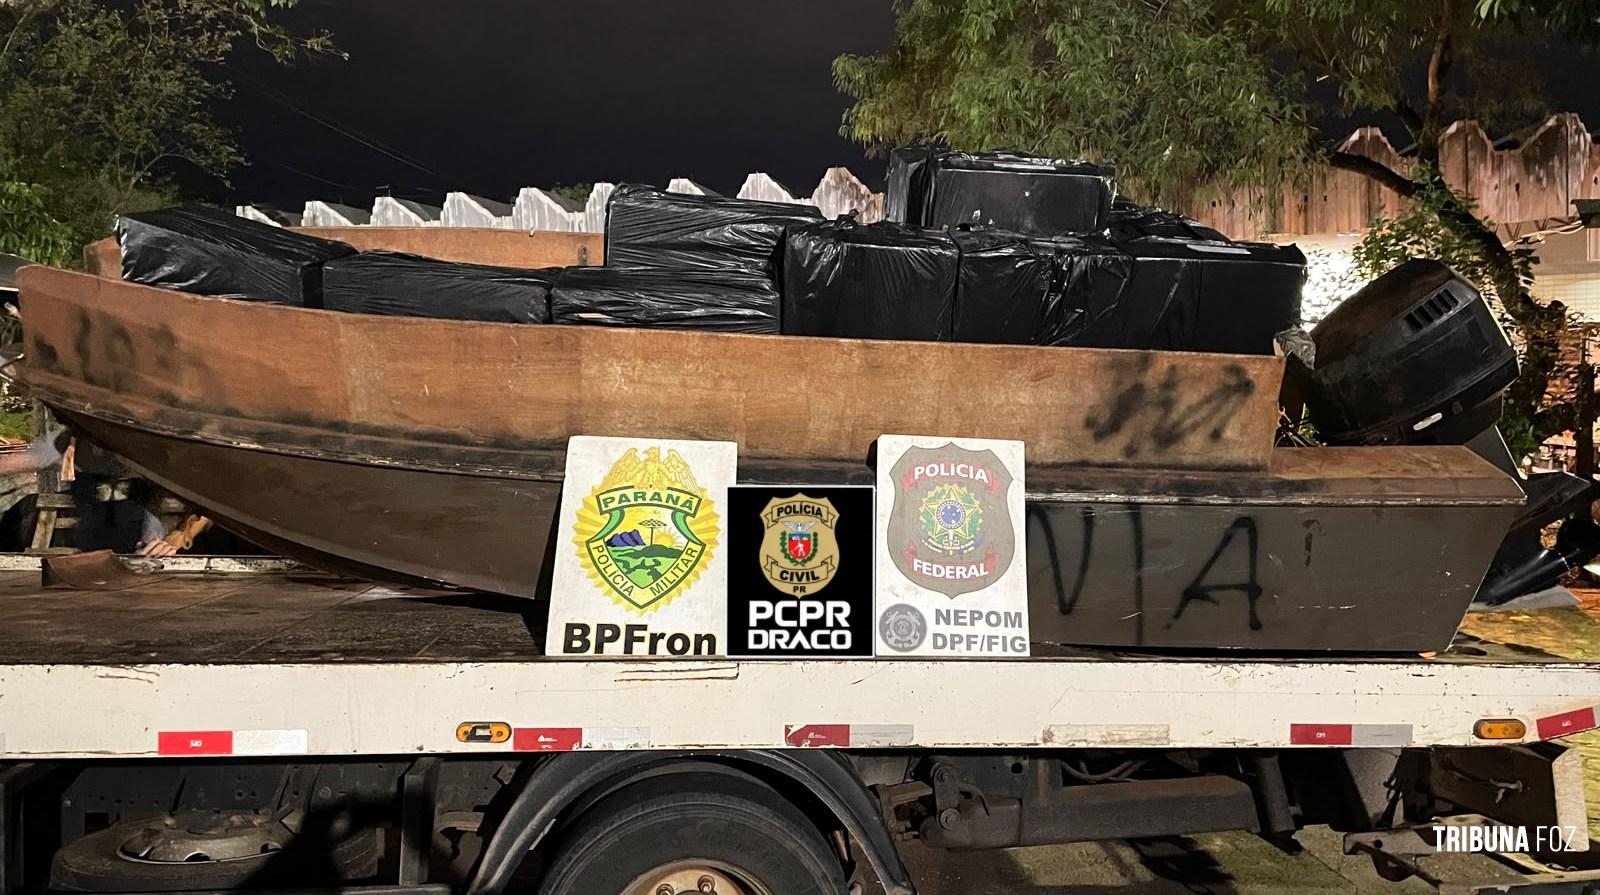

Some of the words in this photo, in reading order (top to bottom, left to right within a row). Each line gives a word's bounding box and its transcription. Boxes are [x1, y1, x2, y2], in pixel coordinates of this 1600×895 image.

[602, 491, 695, 510] PARANÁ
[592, 544, 635, 596] POLÍCIA
[649, 547, 699, 597] MILITAR
[779, 570, 820, 582] CIVIL
[913, 558, 989, 579] FEDERAL
[793, 585, 806, 593] PR
[749, 600, 851, 627] PCPR
[935, 608, 1023, 628] NEPOM
[562, 622, 717, 656] BPFron
[747, 629, 852, 649] DRACO
[932, 632, 1027, 653] DPF/FIG
